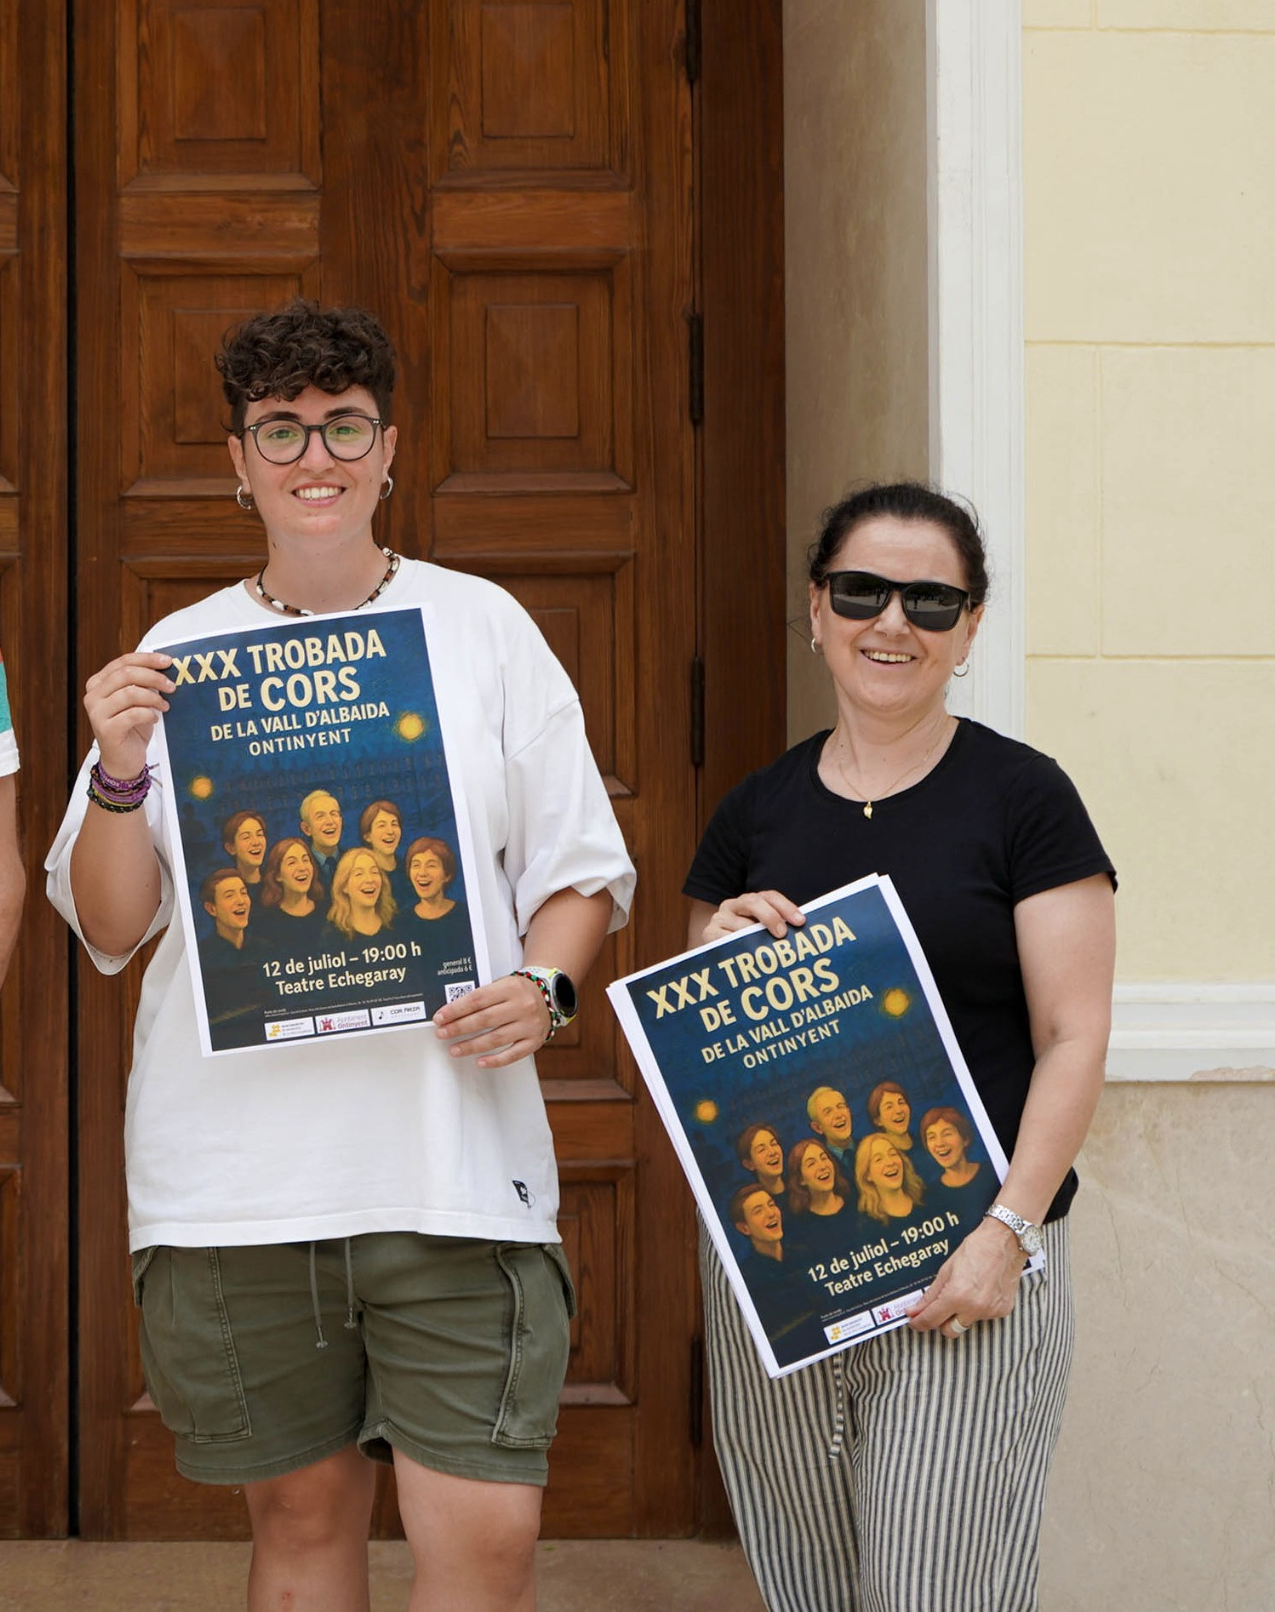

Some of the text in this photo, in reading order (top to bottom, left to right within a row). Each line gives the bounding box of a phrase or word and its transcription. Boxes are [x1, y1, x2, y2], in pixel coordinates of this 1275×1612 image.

[171, 629, 387, 686] XXX TROBADA
[218, 666, 361, 712] DE CORS
[210, 701, 389, 742] DE LA VALL D'ALBAIDA
[249, 728, 351, 756] ONTINYENT
[263, 961, 281, 978] 12
[285, 961, 304, 975] de
[307, 952, 346, 975] juliol
[362, 944, 407, 963] 19:00
[411, 942, 421, 956] h
[275, 965, 406, 995] Teatre Echegaray
[646, 916, 856, 1019] XXX TROBADA
[699, 958, 840, 1033] DE CORS
[701, 984, 873, 1064] DE LA VALL D'ALBAIDA
[743, 1019, 841, 1069] ONTINYENT
[808, 1264, 827, 1282] 12
[830, 1257, 850, 1275] de
[850, 1238, 889, 1270] juliol
[901, 1216, 945, 1246] 19:00
[947, 1211, 960, 1227] h
[824, 1239, 949, 1297] Teatre Echegaray
